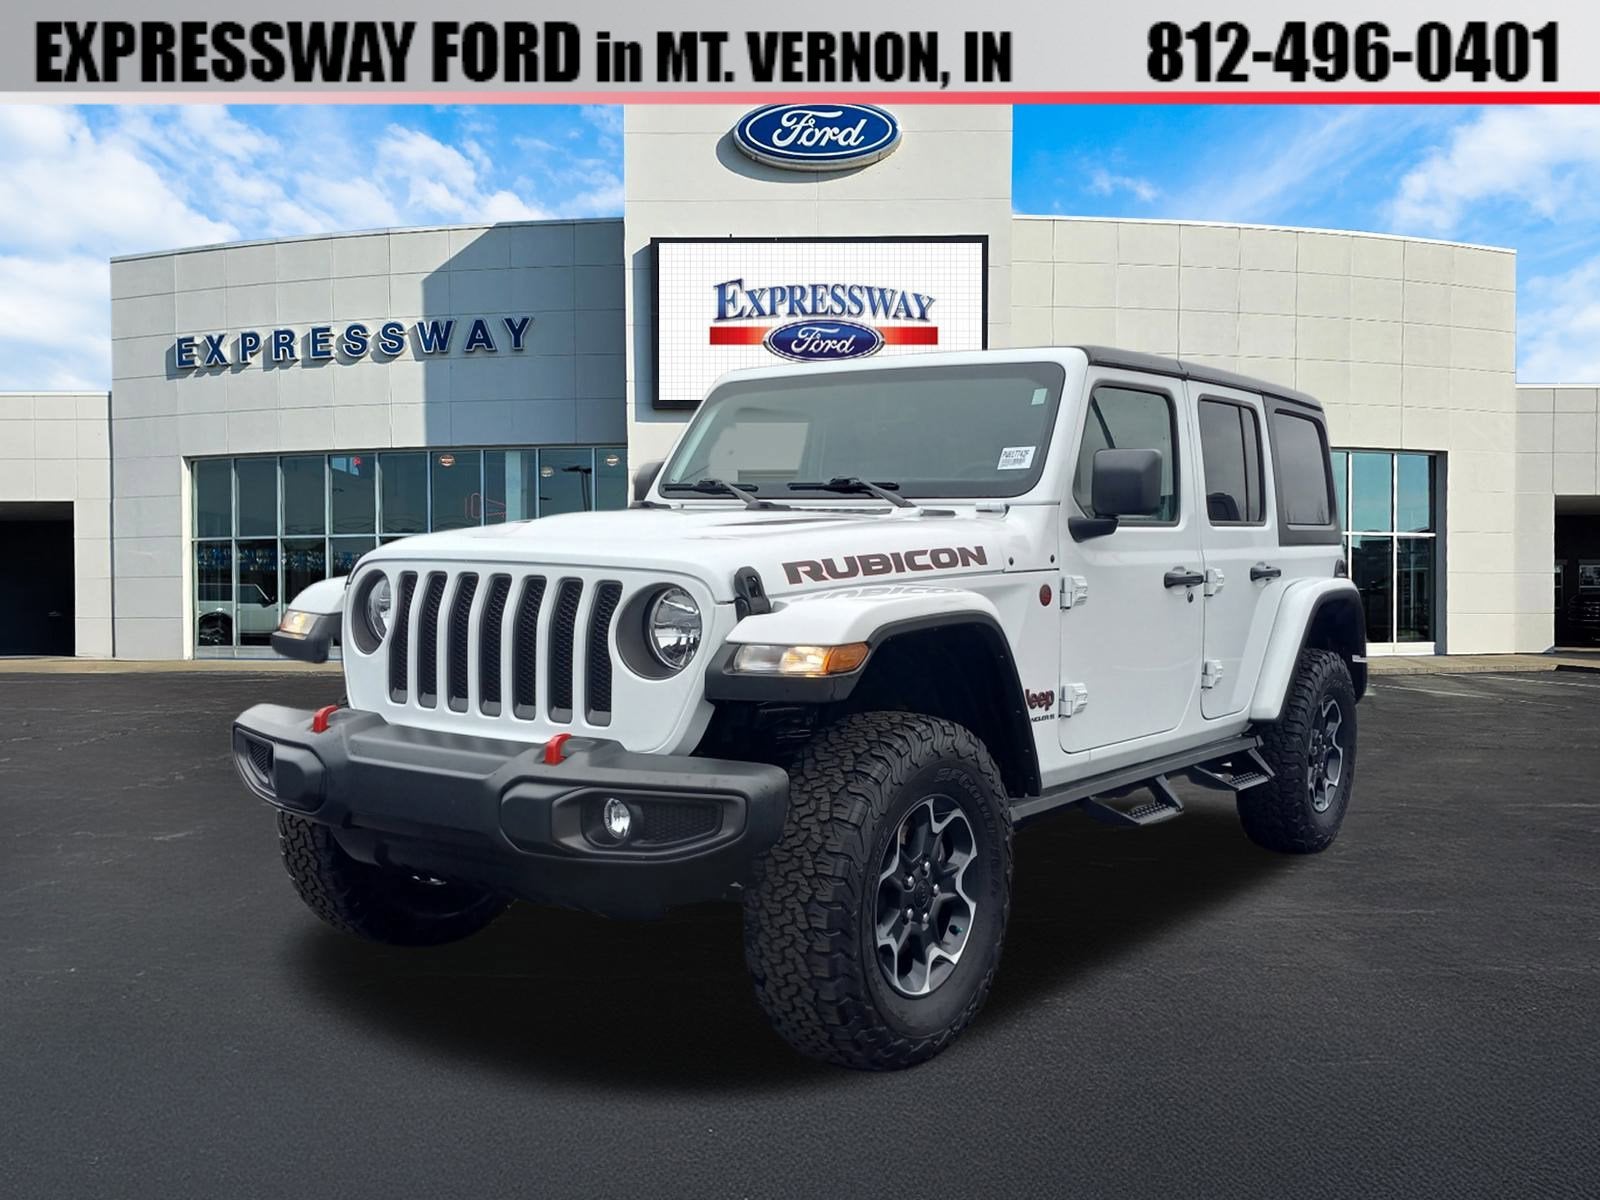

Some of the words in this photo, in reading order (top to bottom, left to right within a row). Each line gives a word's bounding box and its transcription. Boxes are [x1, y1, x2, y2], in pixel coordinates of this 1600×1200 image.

[771, 110, 866, 148] Ford
[712, 278, 936, 323] EXPRESSWAY
[176, 317, 532, 368] EXPRESSWAY
[791, 326, 855, 353] Ford
[782, 545, 988, 585] RUBICON
